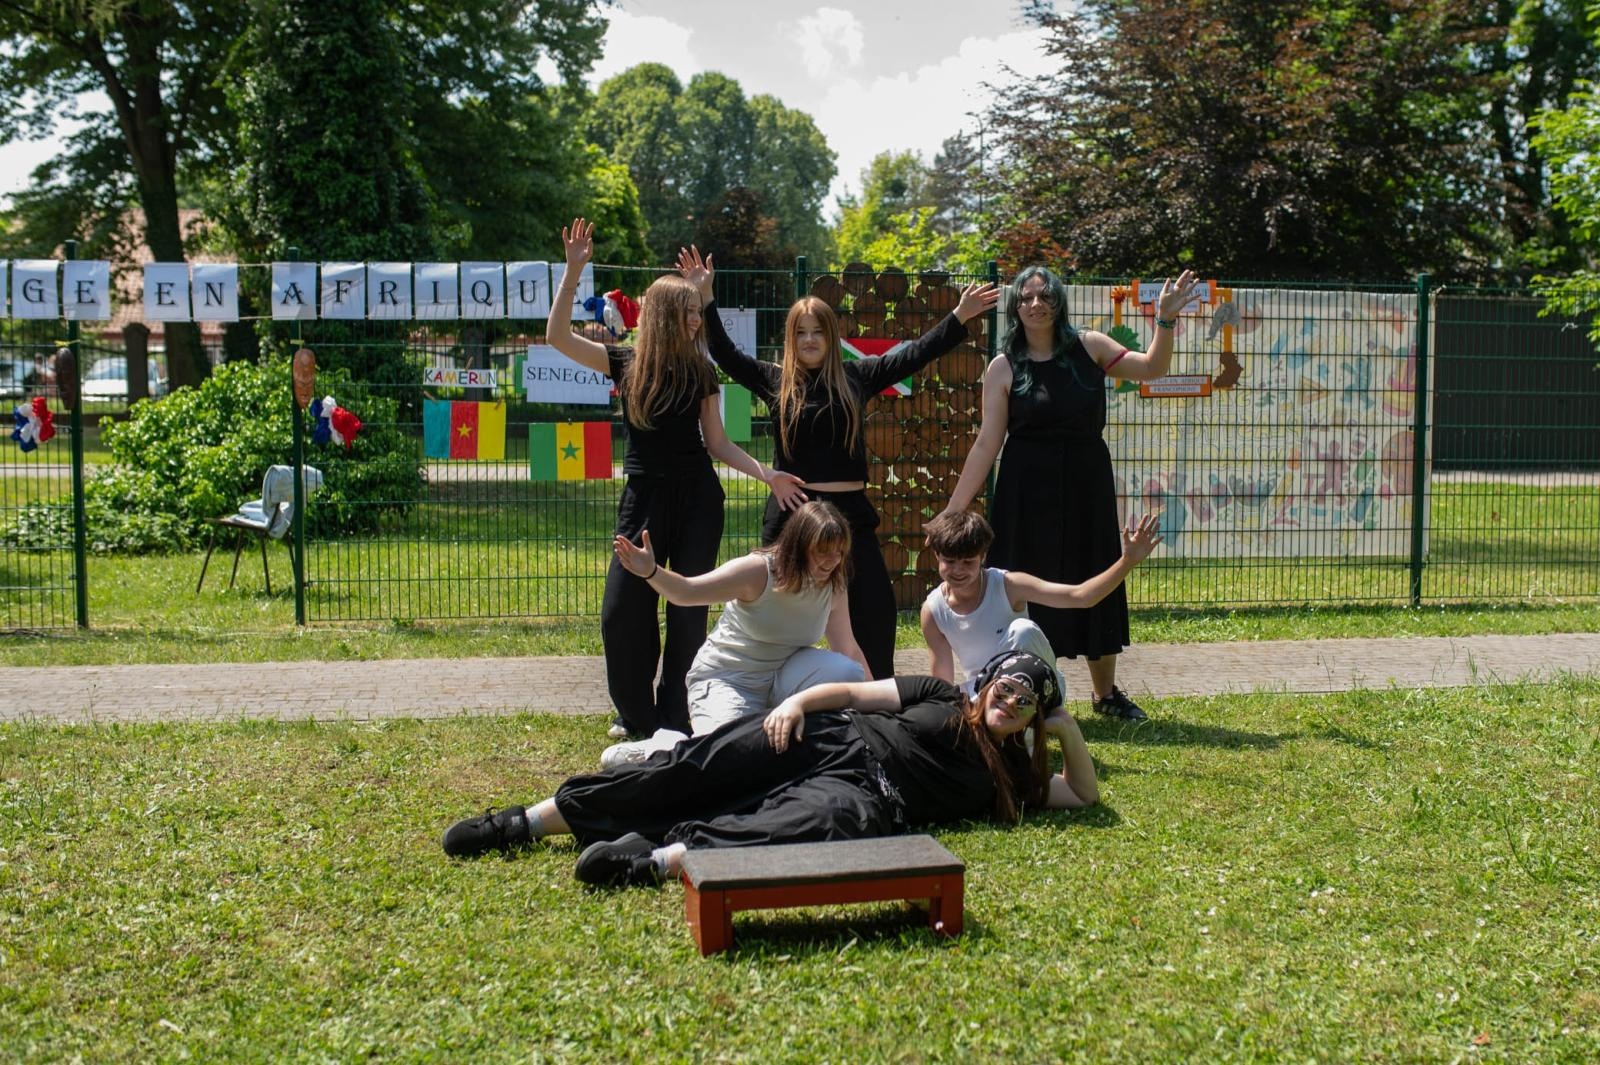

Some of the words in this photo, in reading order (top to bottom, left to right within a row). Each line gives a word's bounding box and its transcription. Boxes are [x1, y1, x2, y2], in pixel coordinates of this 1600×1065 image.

[155, 281, 224, 306] EN
[424, 369, 496, 385] KAMERUN
[526, 366, 612, 386] SENEGAL
